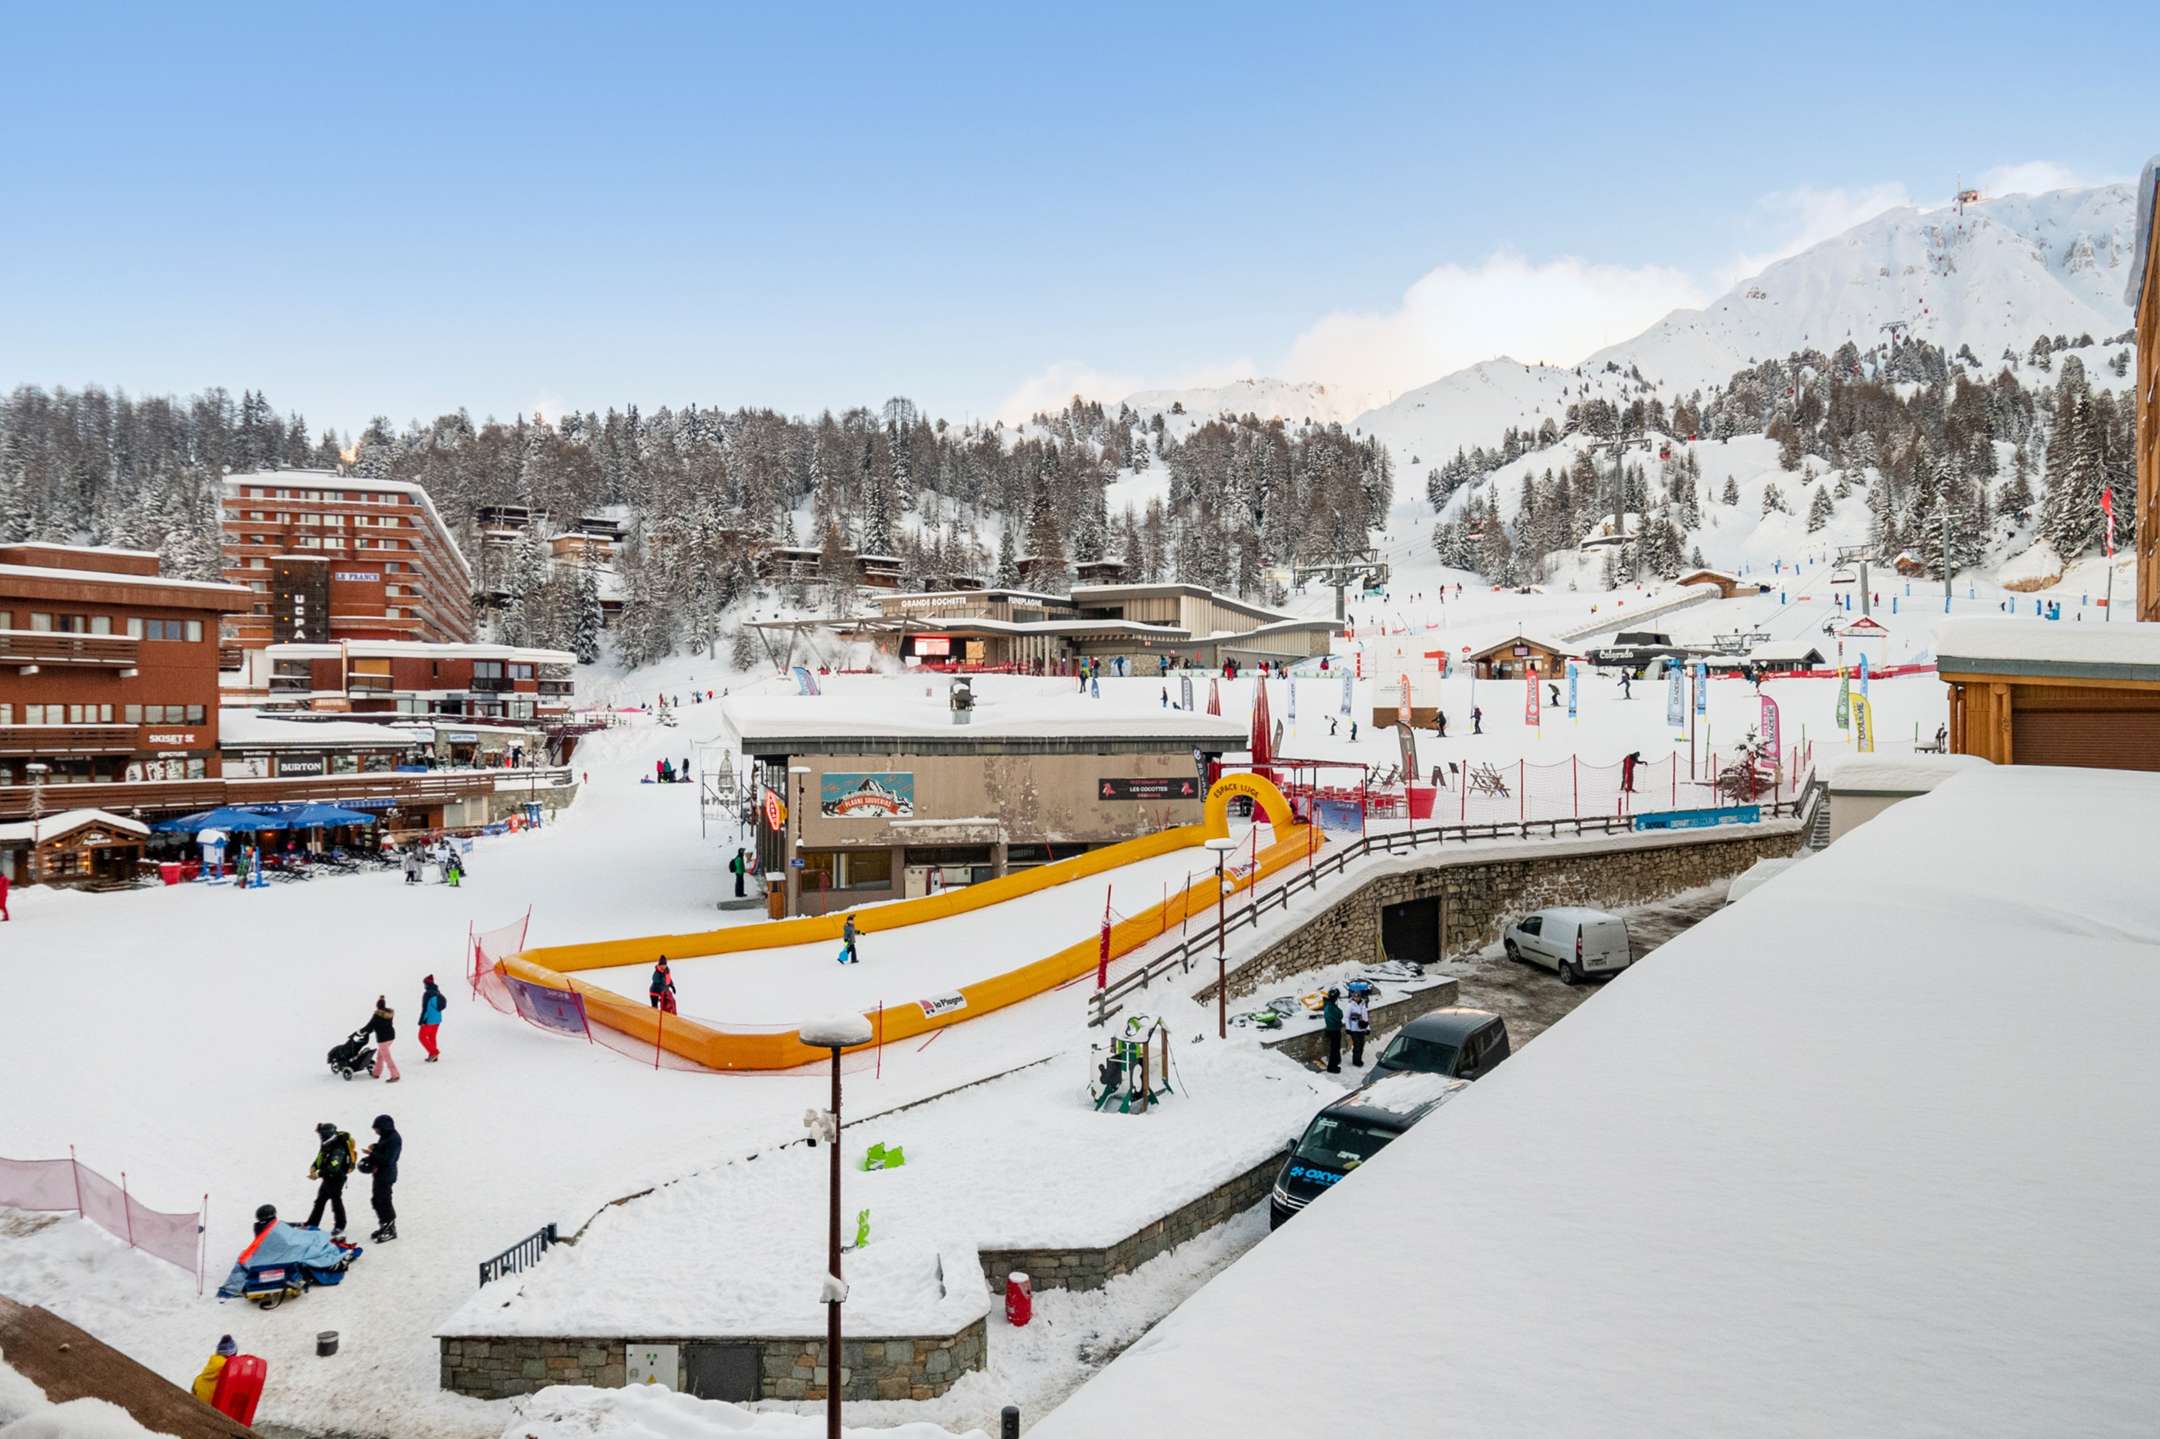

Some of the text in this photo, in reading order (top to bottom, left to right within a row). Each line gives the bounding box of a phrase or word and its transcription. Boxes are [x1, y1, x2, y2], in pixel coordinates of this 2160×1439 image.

[901, 597, 967, 608] GRANDE ROCHETTE
[293, 594, 306, 639] UCPA
[1599, 648, 1634, 662] Colorado
[281, 762, 322, 772] BURTON
[1213, 783, 1260, 799] ESPACE LUGE
[940, 996, 963, 1006] Plagne
